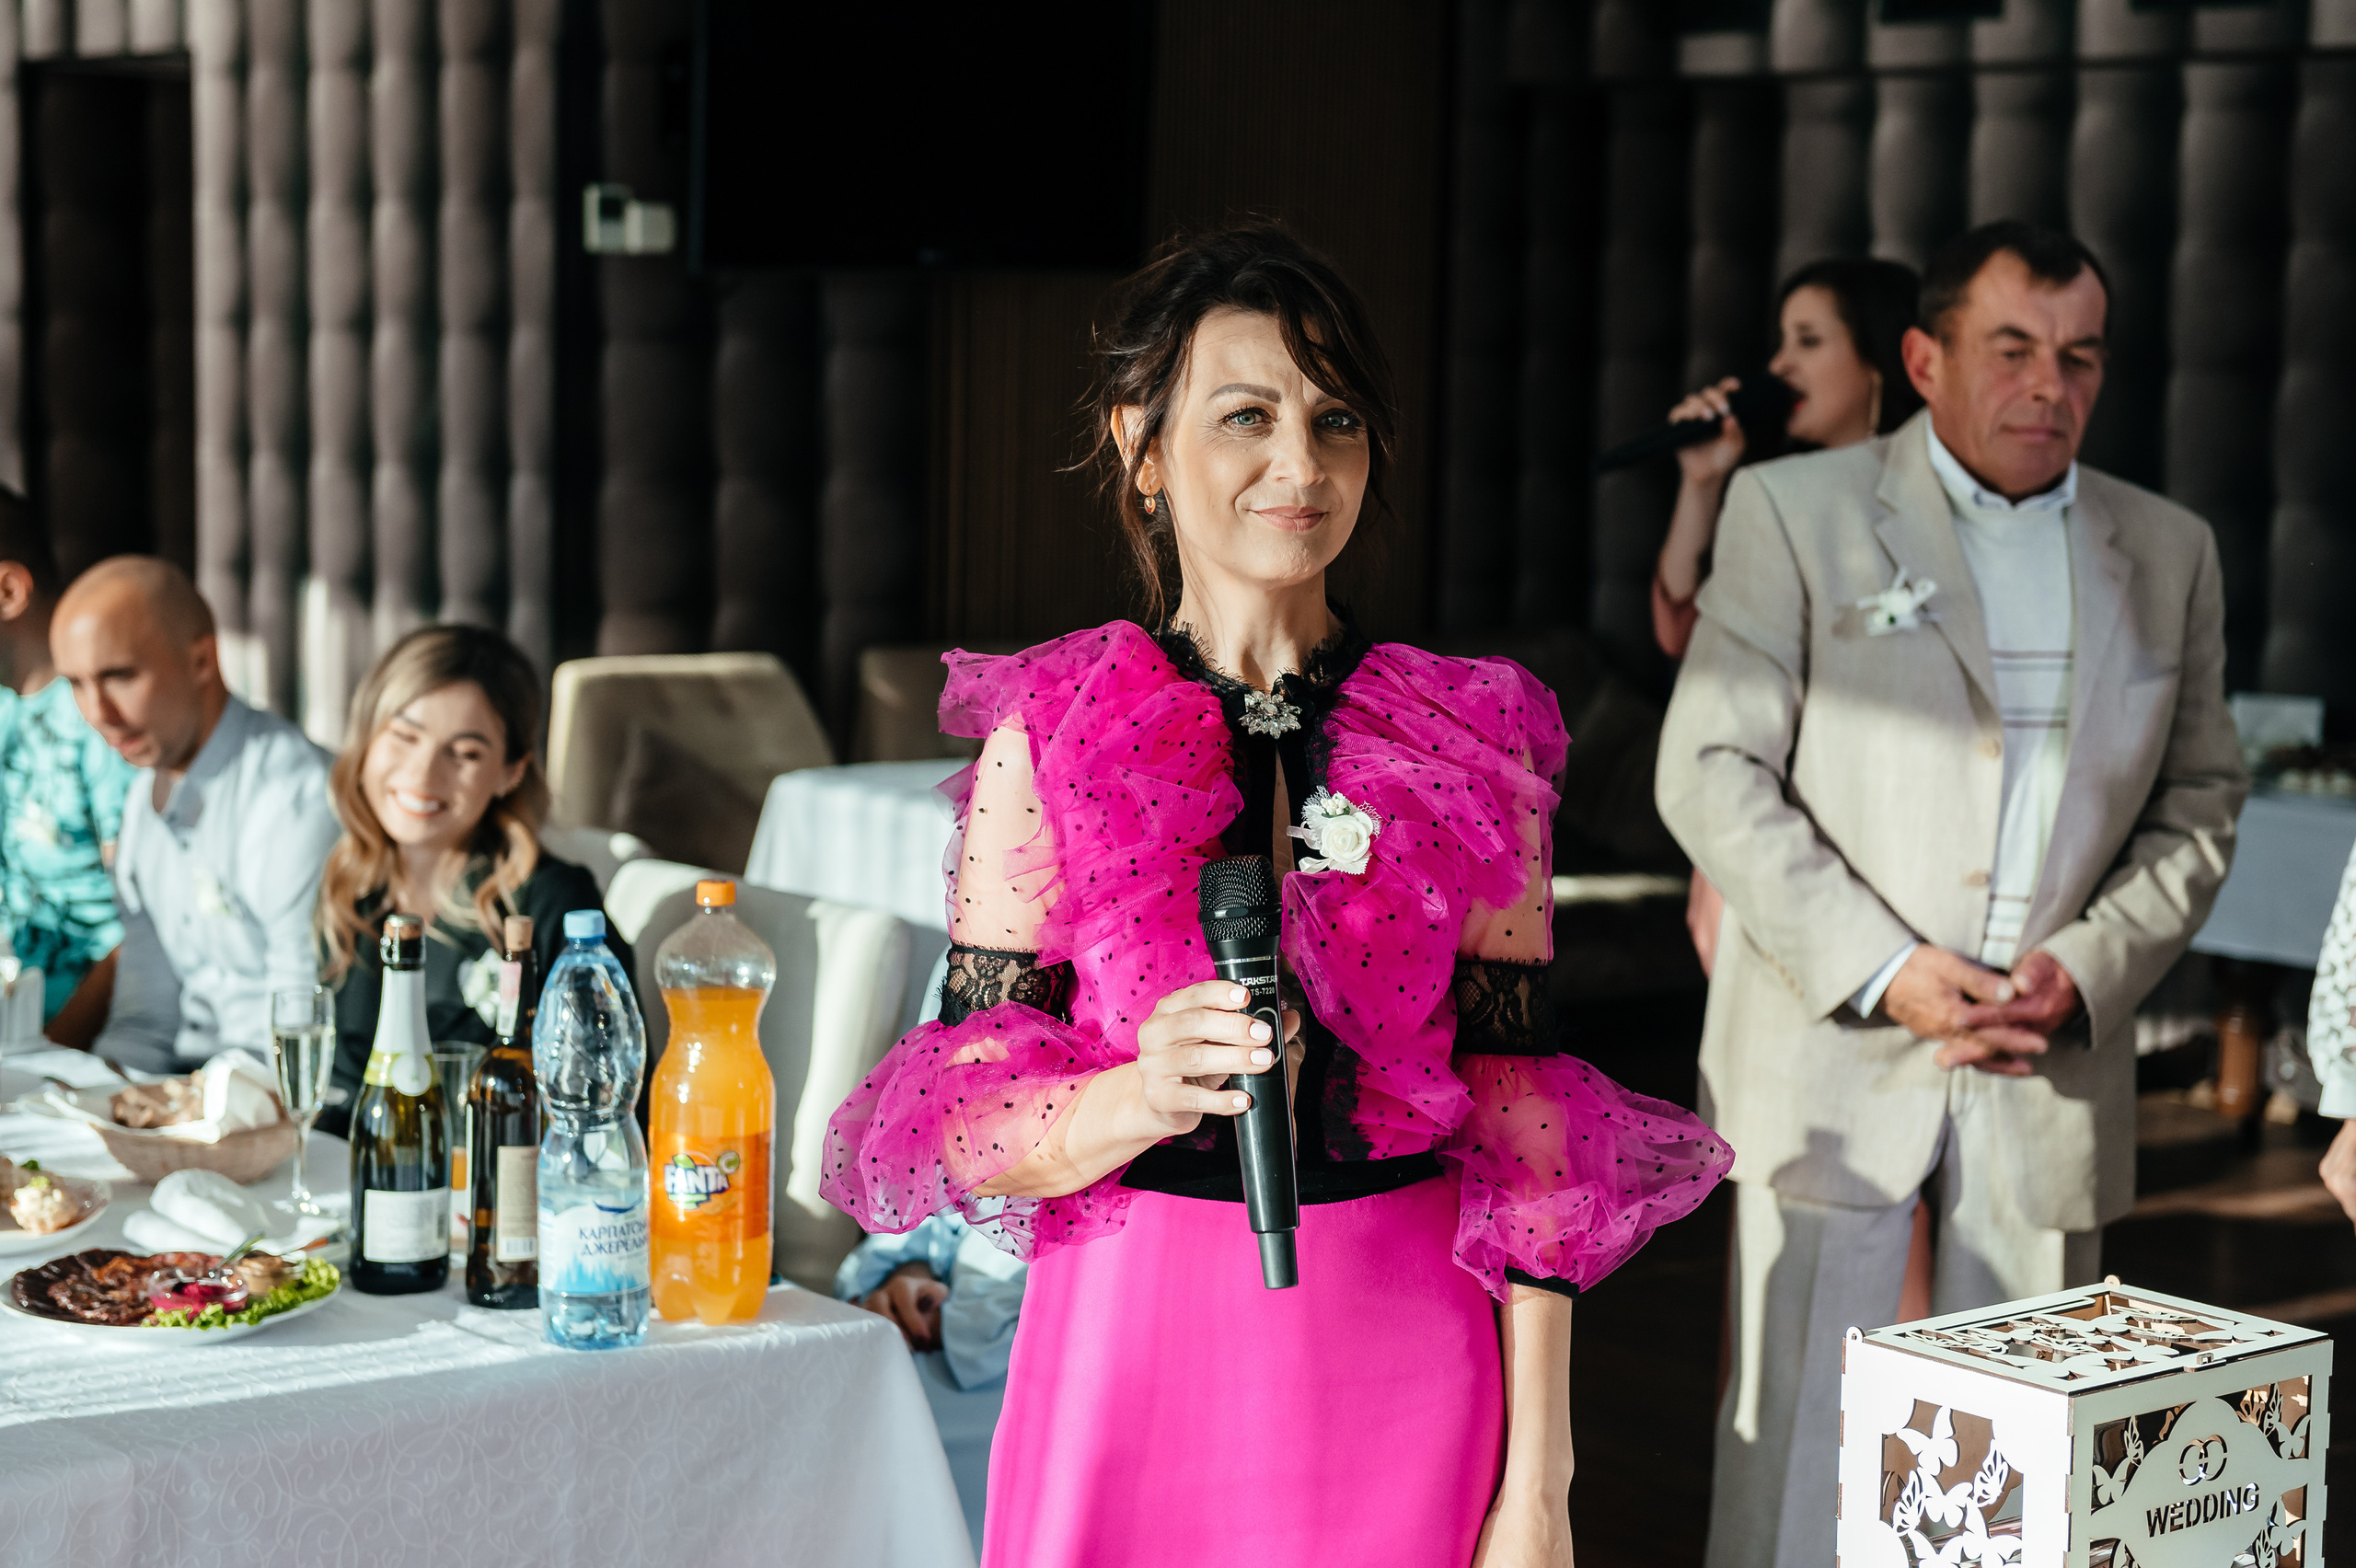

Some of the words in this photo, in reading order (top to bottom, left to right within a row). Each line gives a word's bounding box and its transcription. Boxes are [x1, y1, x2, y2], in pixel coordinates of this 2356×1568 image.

[1239, 975, 1278, 986] TAKSTAR
[1250, 986, 1276, 996] TS-7220
[2146, 1482, 2260, 1539] WEDDING
